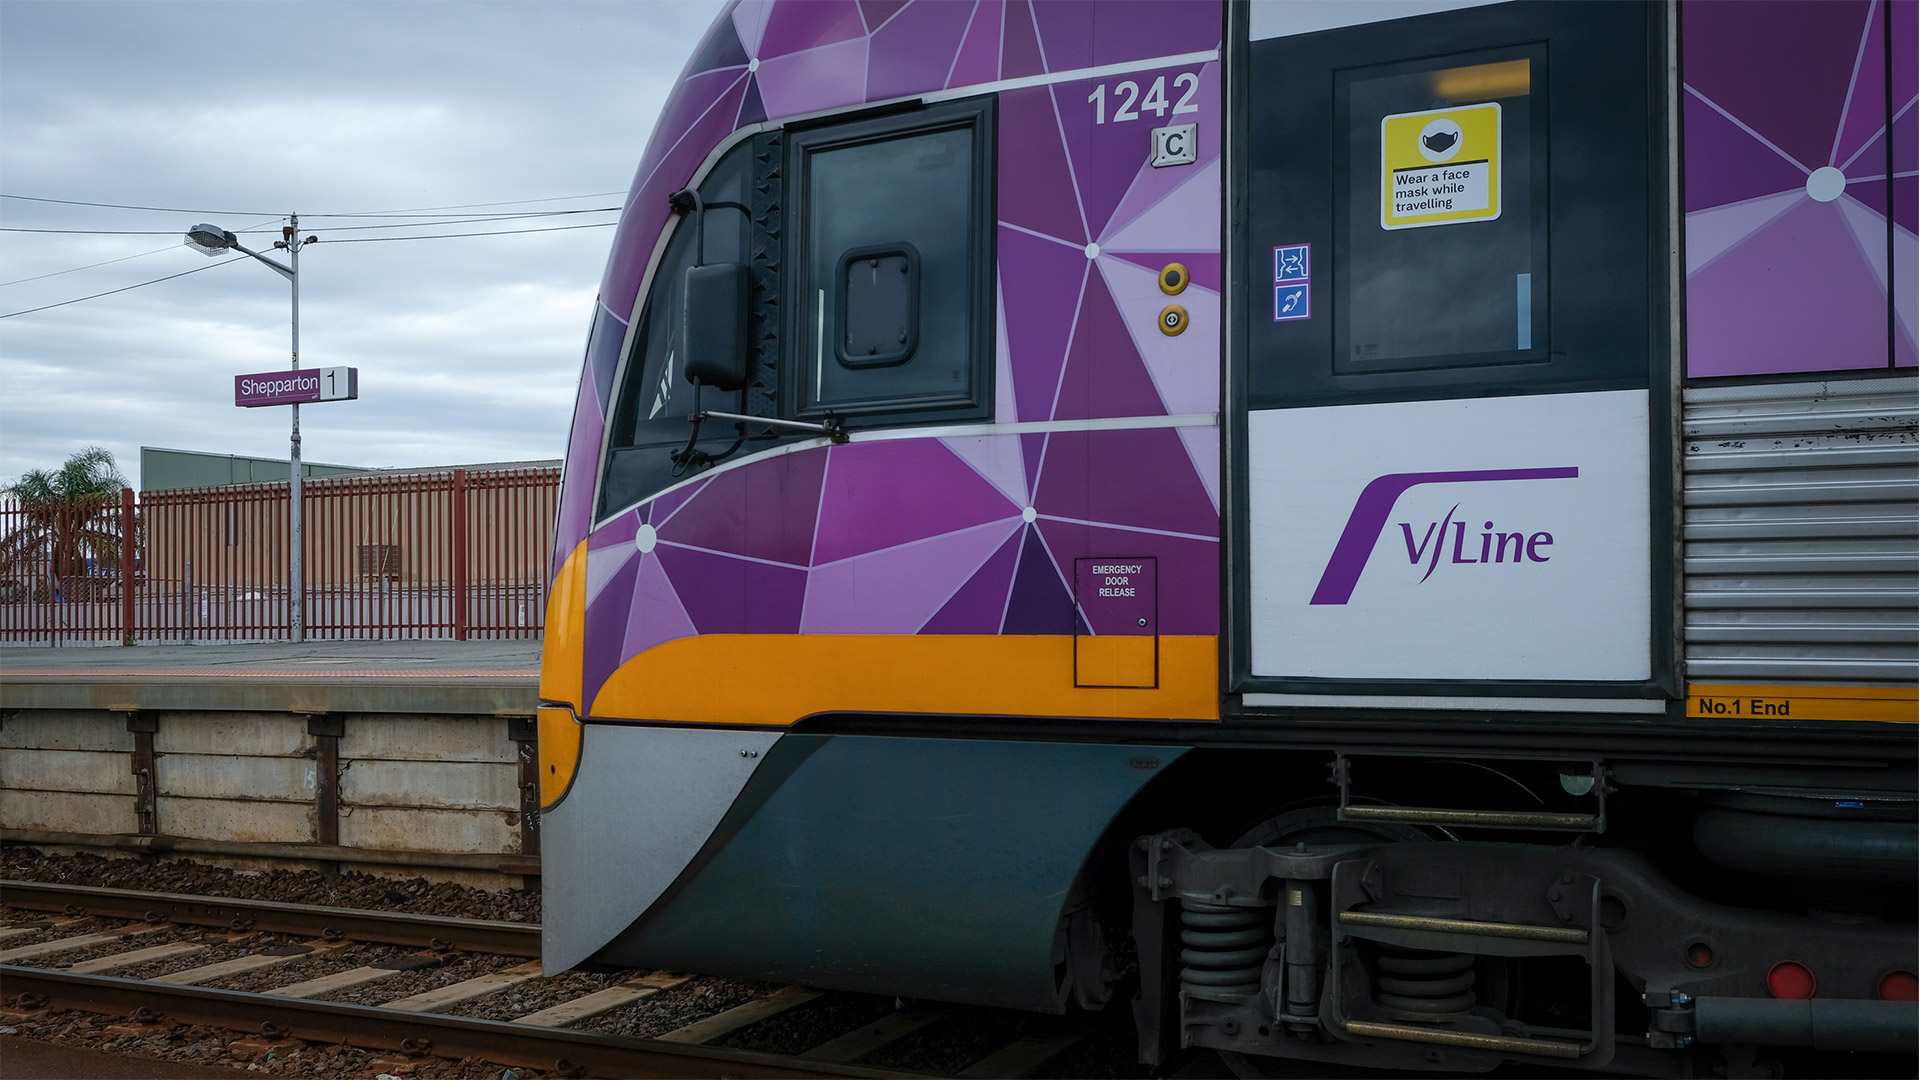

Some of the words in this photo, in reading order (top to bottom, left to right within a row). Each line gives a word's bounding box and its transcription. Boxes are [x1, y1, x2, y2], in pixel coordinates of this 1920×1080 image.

[1088, 72, 1199, 124] 1242
[1165, 133, 1184, 156] C
[1396, 174, 1428, 186] Wear
[1431, 173, 1439, 182] a
[1442, 170, 1470, 181] face
[1395, 186, 1428, 199] mask
[1432, 182, 1465, 195] while
[1396, 198, 1453, 212] travelling
[241, 375, 319, 397] Shepparton
[326, 369, 335, 396] 1
[1397, 502, 1554, 585] V/Line
[1092, 565, 1142, 574] EMERGENCY
[1105, 576, 1129, 586] DOOR
[1099, 588, 1136, 597] RELEASE
[1699, 698, 1741, 715] No.1
[1750, 699, 1790, 716] End
